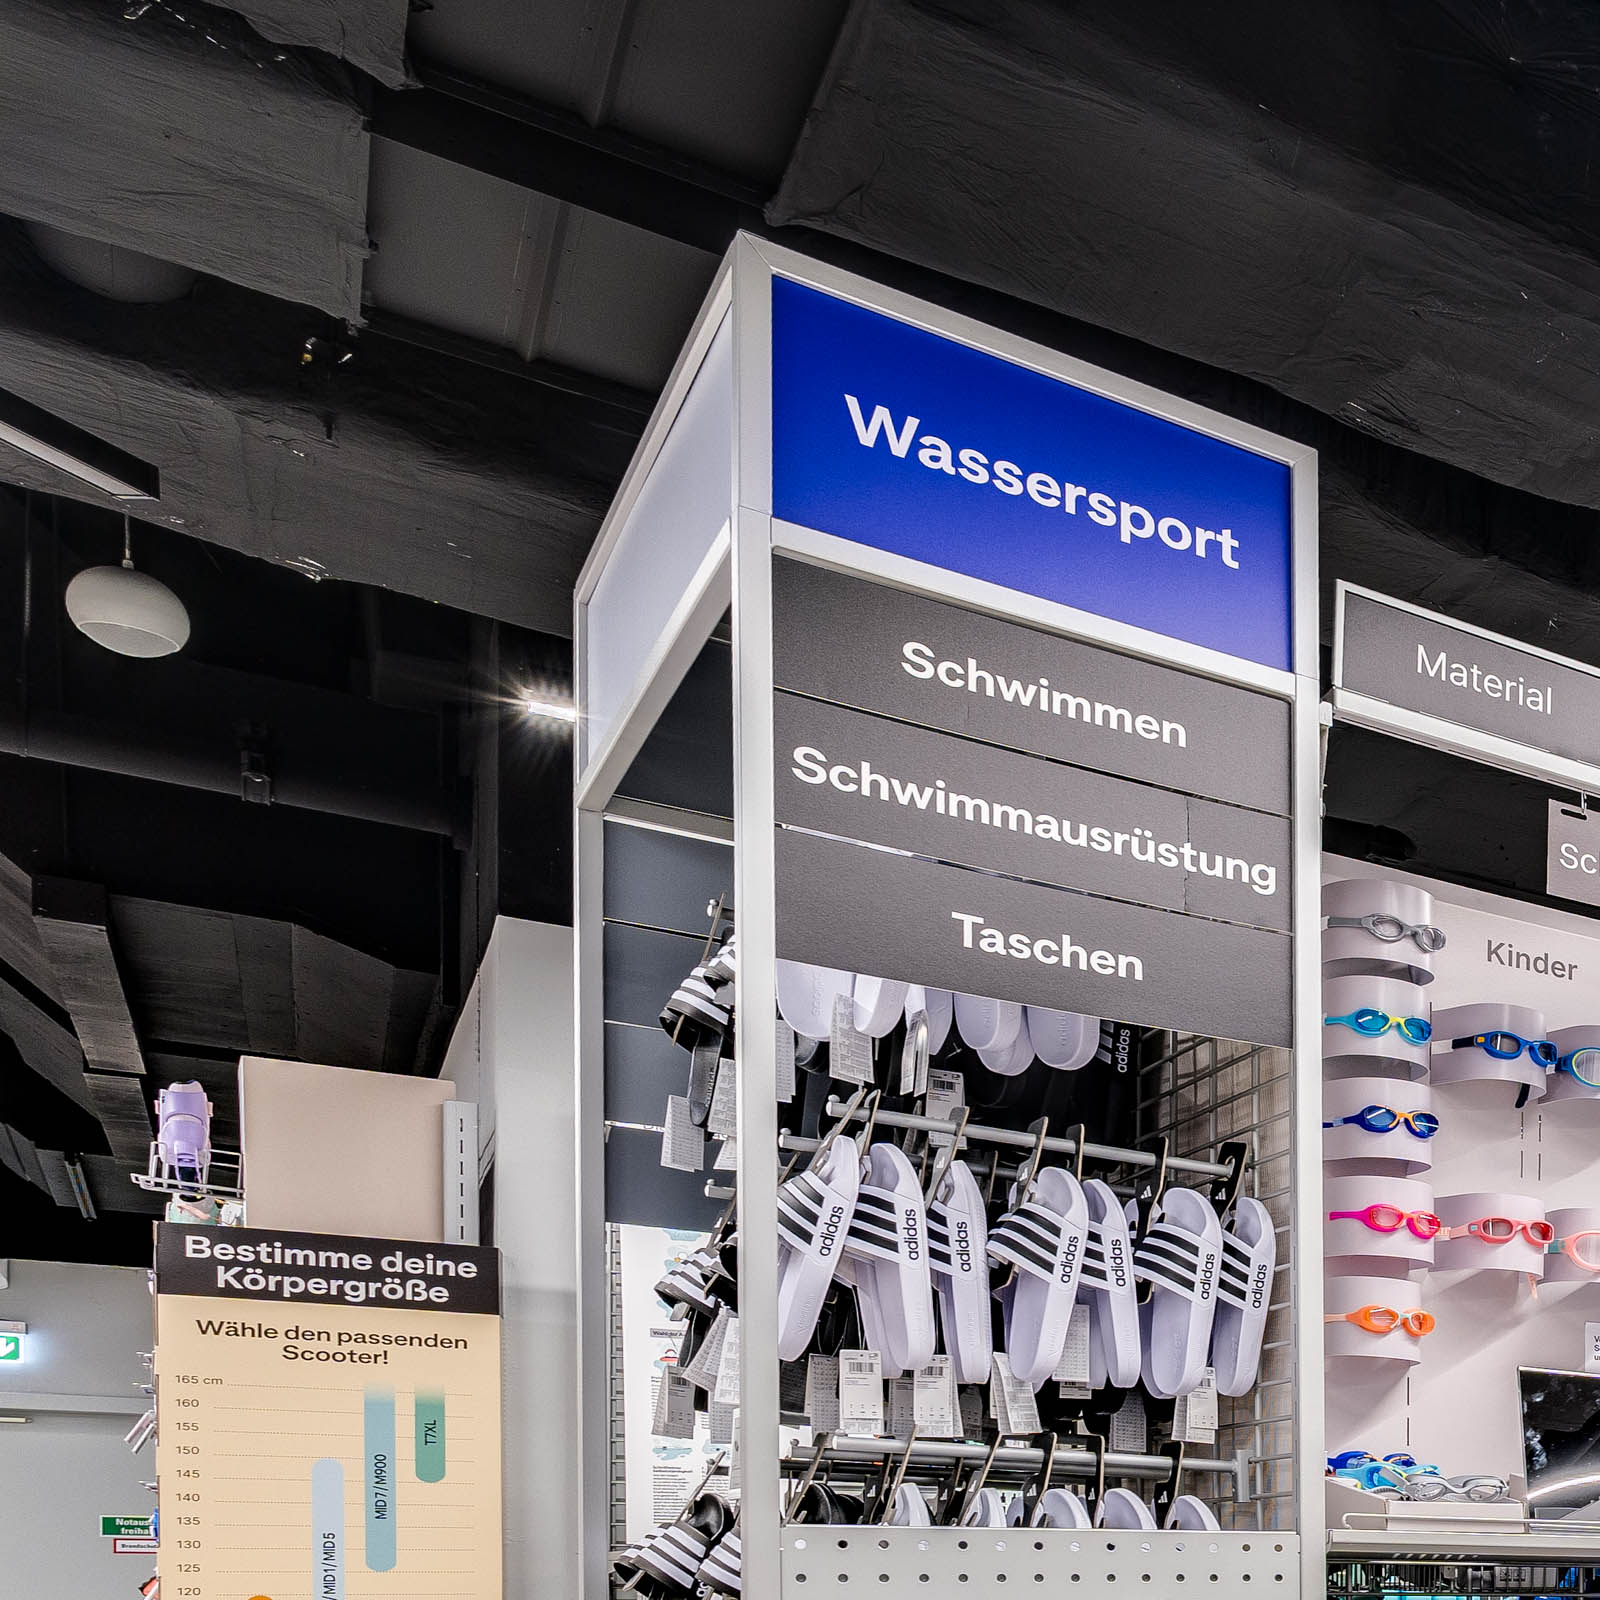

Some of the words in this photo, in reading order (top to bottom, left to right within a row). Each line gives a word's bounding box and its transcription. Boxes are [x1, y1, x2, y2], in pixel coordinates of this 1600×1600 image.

[844, 392, 1242, 571] Wassersport
[901, 640, 1188, 749] Schwimmen
[1415, 643, 1554, 716] Material
[790, 745, 1278, 896] Schwimmausrüstung
[951, 909, 1145, 982] Taschen
[1486, 939, 1579, 981] Kinder
[1117, 1028, 1131, 1073] adidas
[818, 1205, 845, 1258] adidas
[903, 1207, 918, 1262] adidas
[956, 1220, 971, 1273] adidas
[184, 1234, 373, 1271] Bestimme
[380, 1251, 479, 1279] deine
[1060, 1235, 1080, 1285] adidas
[1115, 1237, 1126, 1288] adidas
[1200, 1251, 1216, 1302] adidas
[216, 1264, 450, 1303] Körpergröße
[1251, 1263, 1267, 1310] adidas
[195, 1318, 279, 1340] Wähle
[284, 1325, 331, 1343] den
[337, 1330, 469, 1350] passenden
[281, 1345, 390, 1366] Scooter!
[175, 1374, 199, 1385] 165
[203, 1376, 224, 1386] cm
[176, 1398, 200, 1408] 160
[176, 1422, 200, 1431] 155
[424, 1419, 437, 1446] T7XL
[176, 1446, 200, 1455] 150
[176, 1469, 200, 1479] 145
[176, 1492, 201, 1502] 140
[176, 1516, 201, 1526] 135
[176, 1540, 201, 1550] 130
[176, 1563, 201, 1573] 125
[176, 1587, 202, 1597] 120
